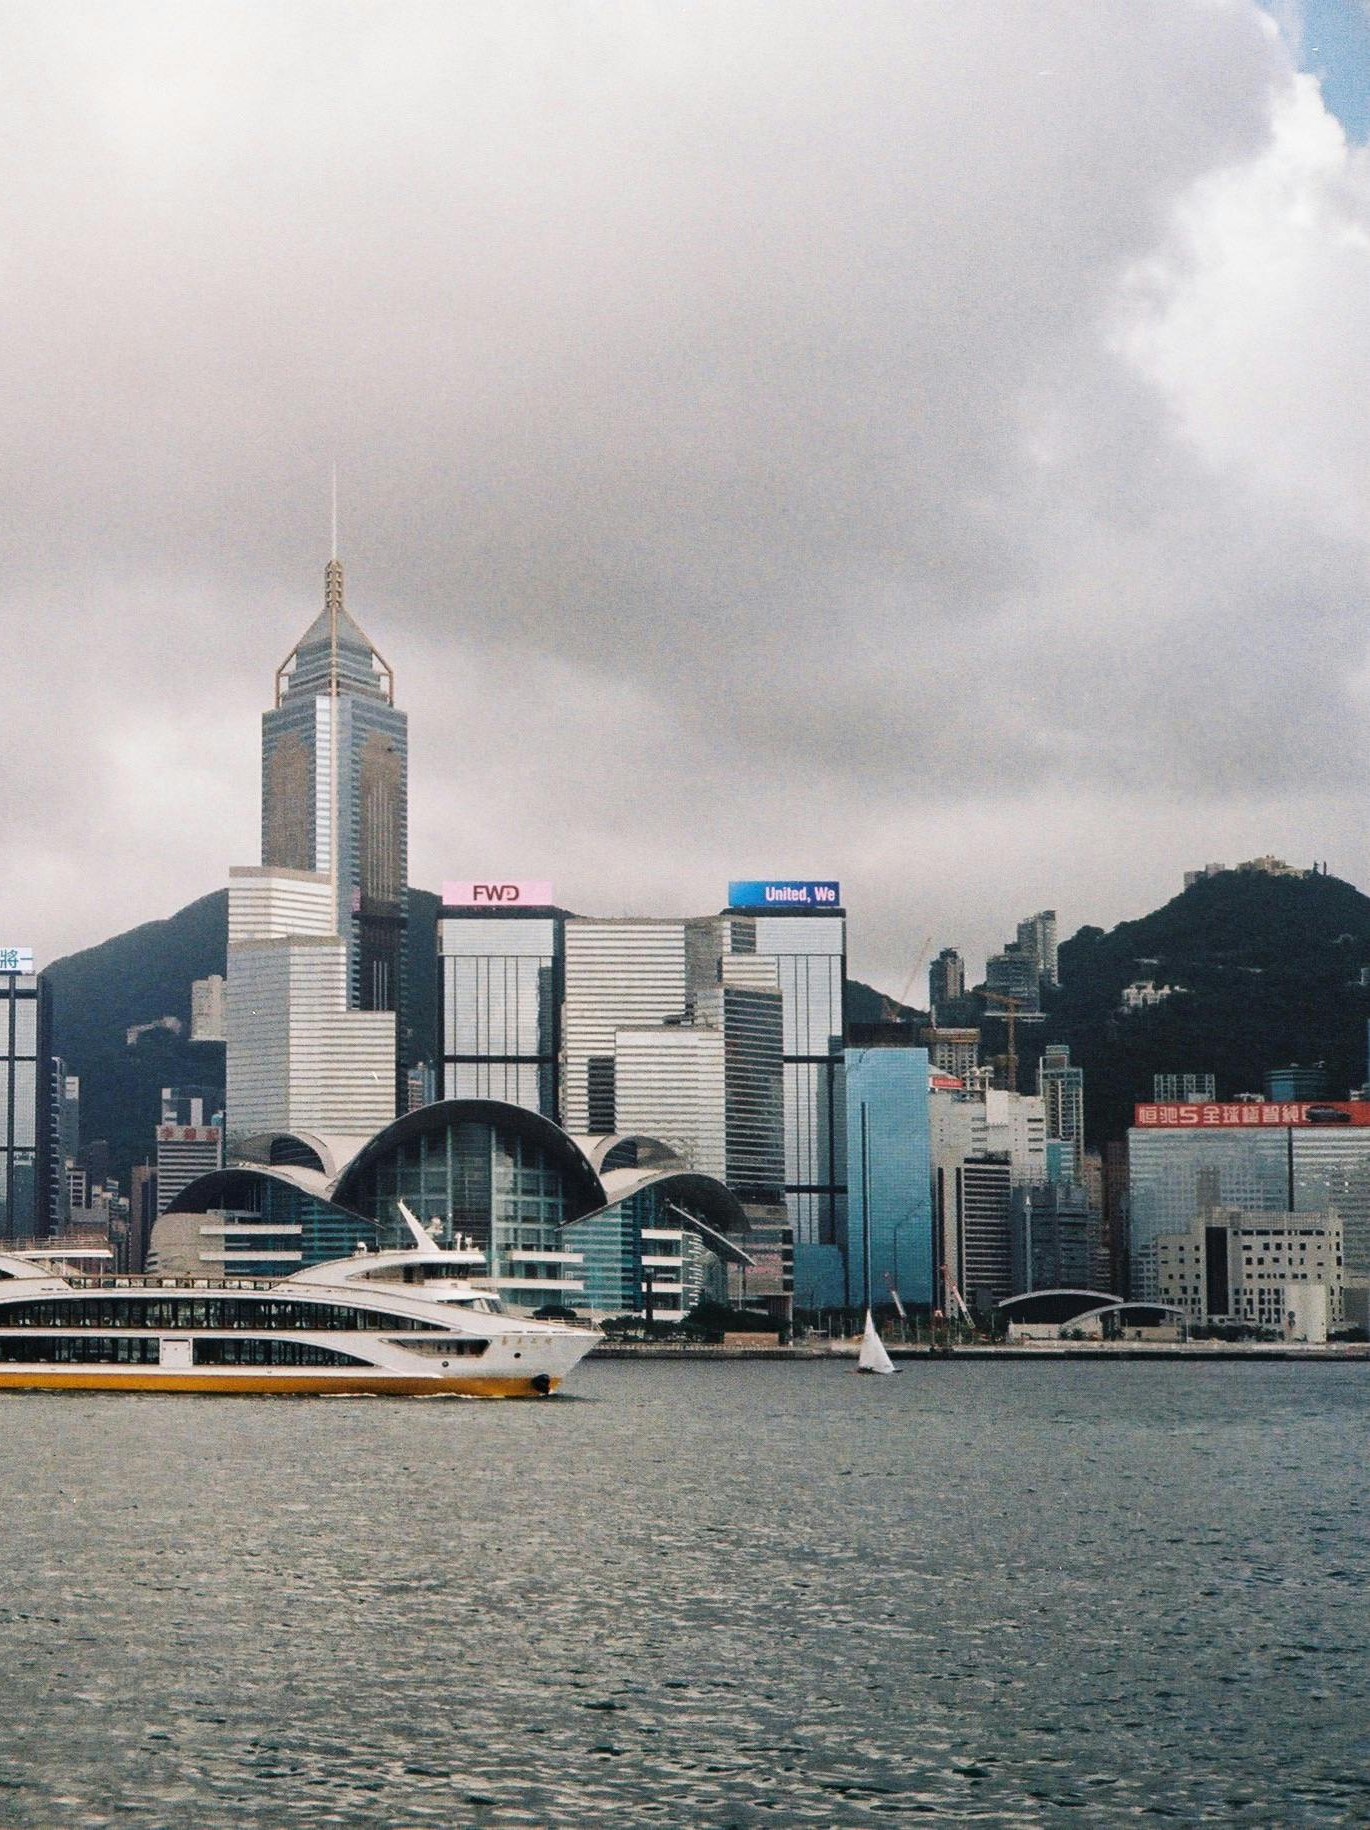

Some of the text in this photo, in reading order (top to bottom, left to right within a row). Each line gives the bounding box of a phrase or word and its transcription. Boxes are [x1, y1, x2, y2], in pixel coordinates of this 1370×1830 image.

[473, 885, 519, 901] FWD
[765, 886, 835, 903] United, We
